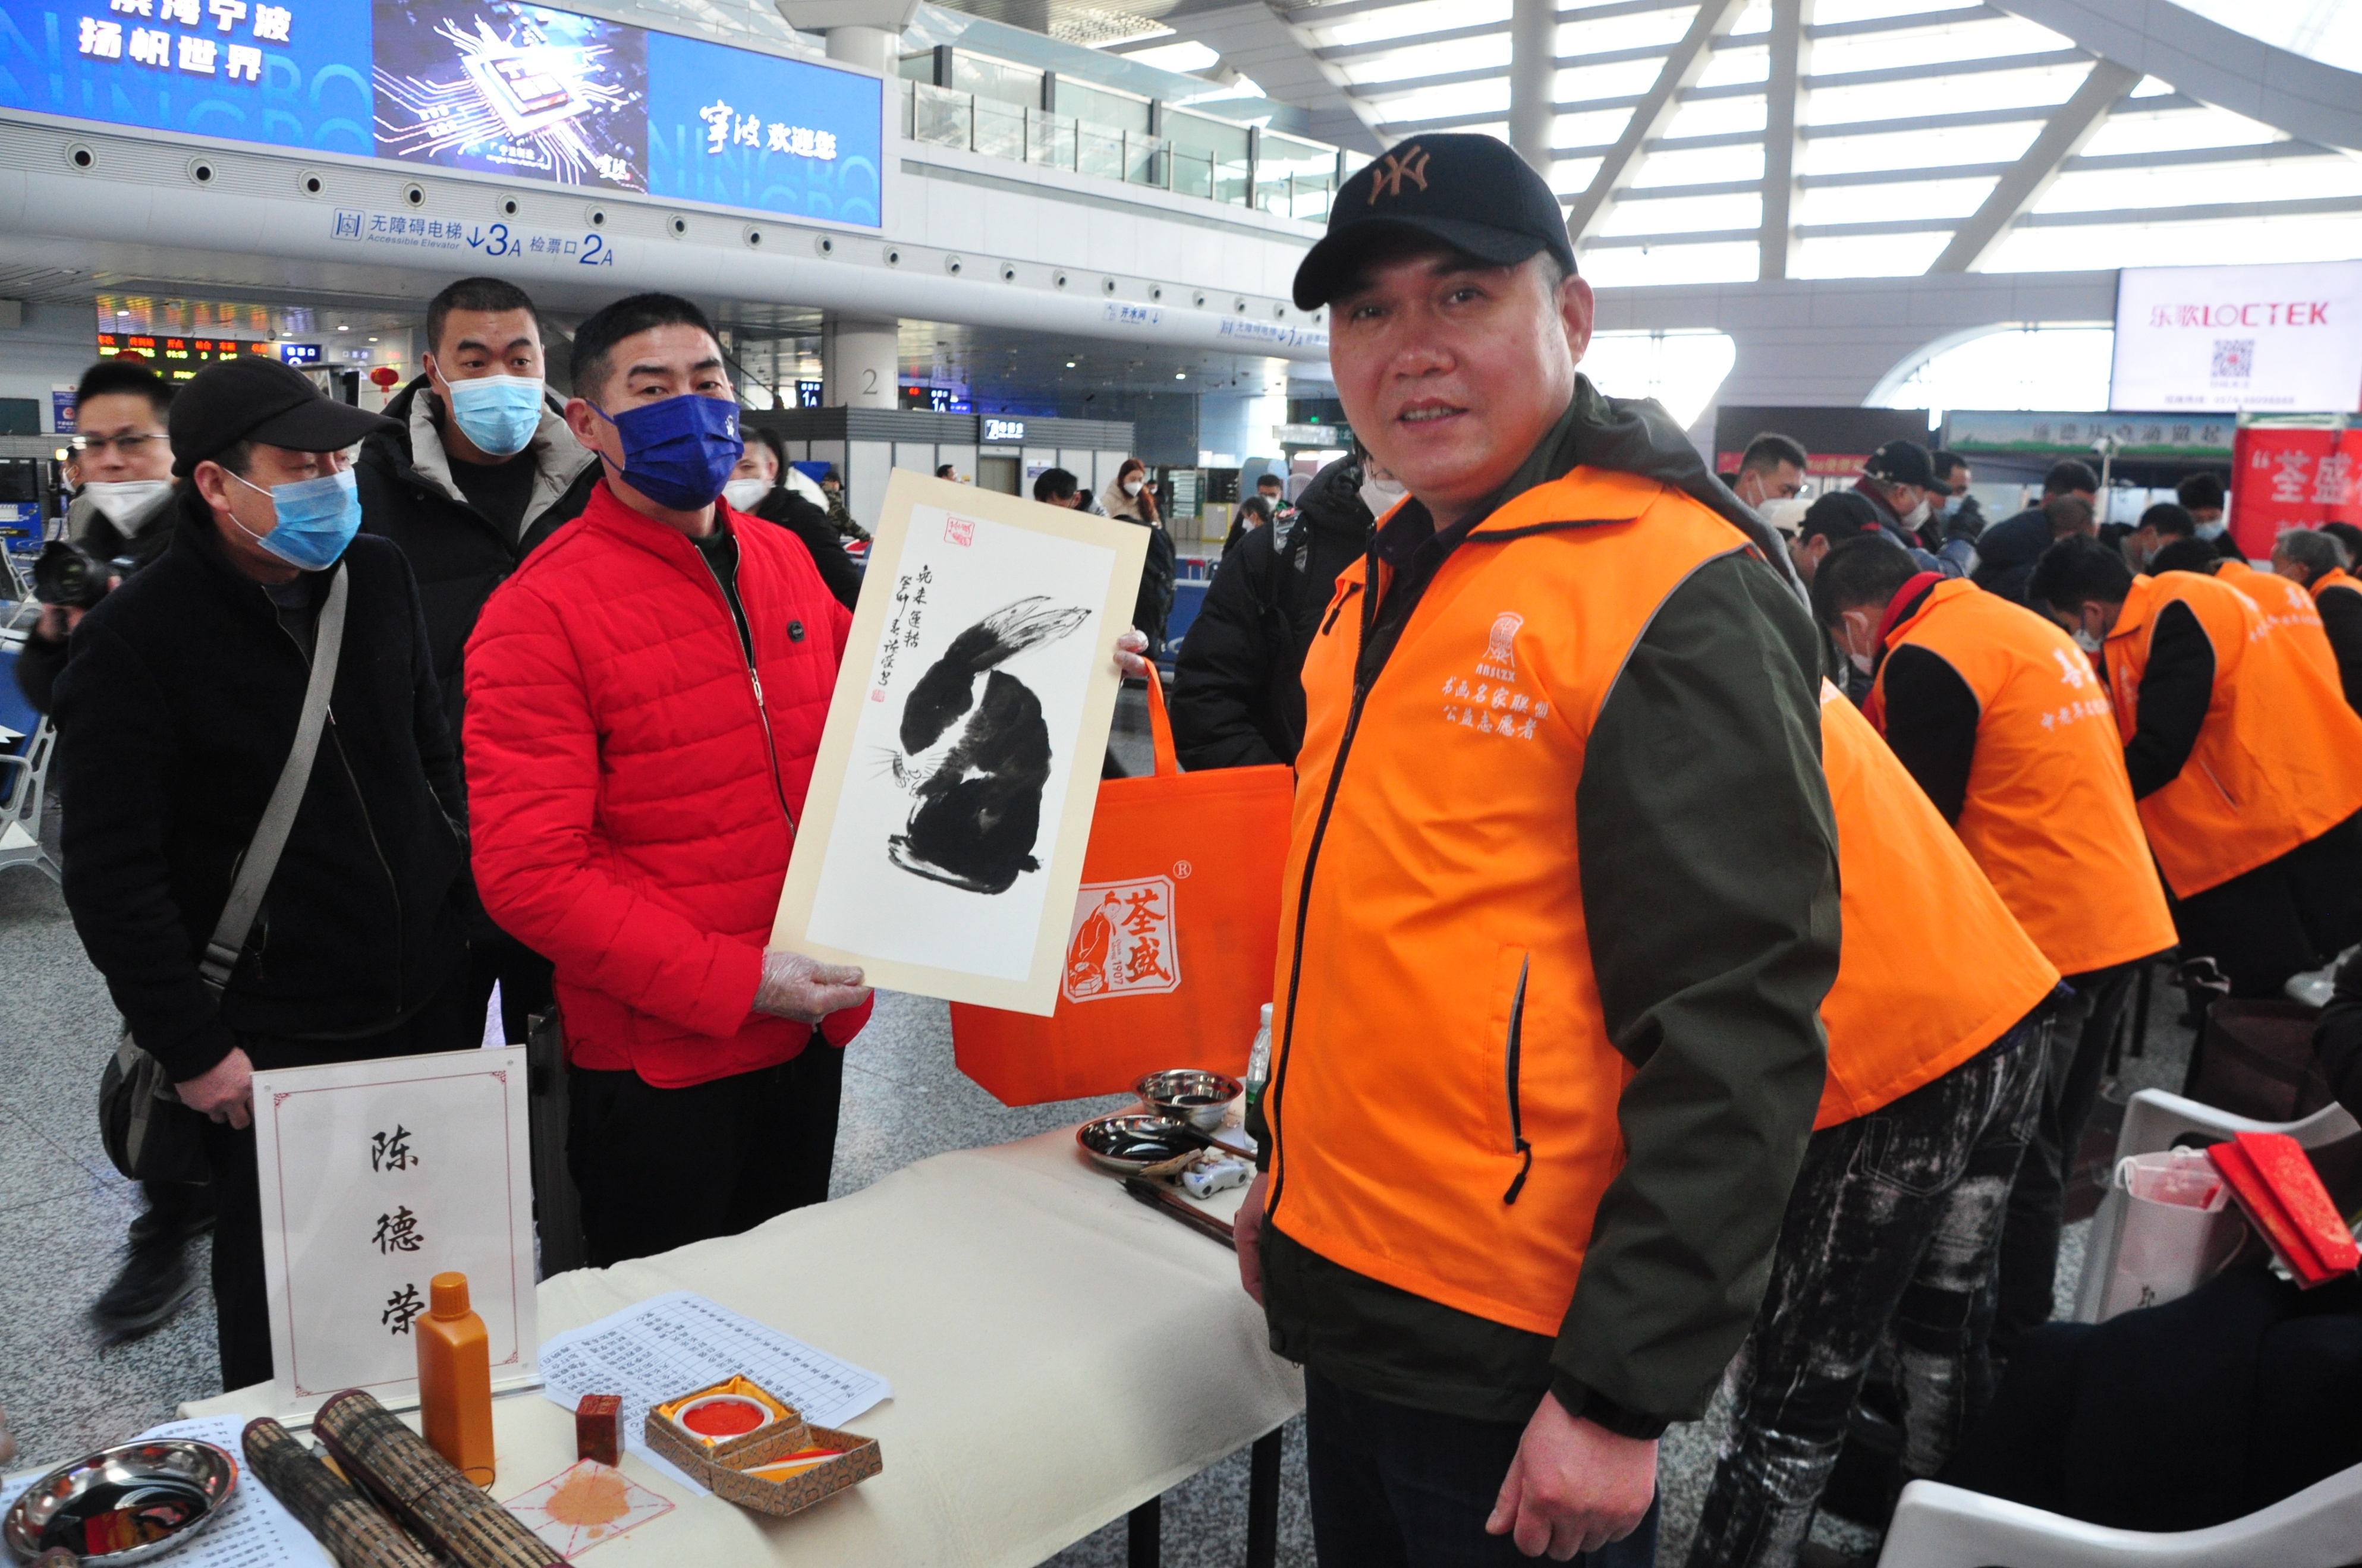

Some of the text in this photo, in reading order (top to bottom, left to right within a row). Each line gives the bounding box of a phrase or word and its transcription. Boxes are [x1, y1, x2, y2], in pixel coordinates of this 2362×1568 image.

[78, 17, 262, 81] 扬帆世界
[767, 122, 837, 160] 欢迎您
[367, 234, 460, 250] Accessible Elevator
[370, 215, 463, 241] 无障碍电梯
[486, 223, 614, 266] 3A 检票口 2A
[862, 369, 878, 395] 2
[2251, 449, 2362, 505] “荃盛
[1442, 676, 1549, 720] 书画名家联盟
[1443, 705, 1537, 741] 公益志愿者
[1121, 889, 1171, 983] 荃盛
[1112, 961, 1124, 985] 1907
[371, 1124, 424, 1335] 陈德荣
